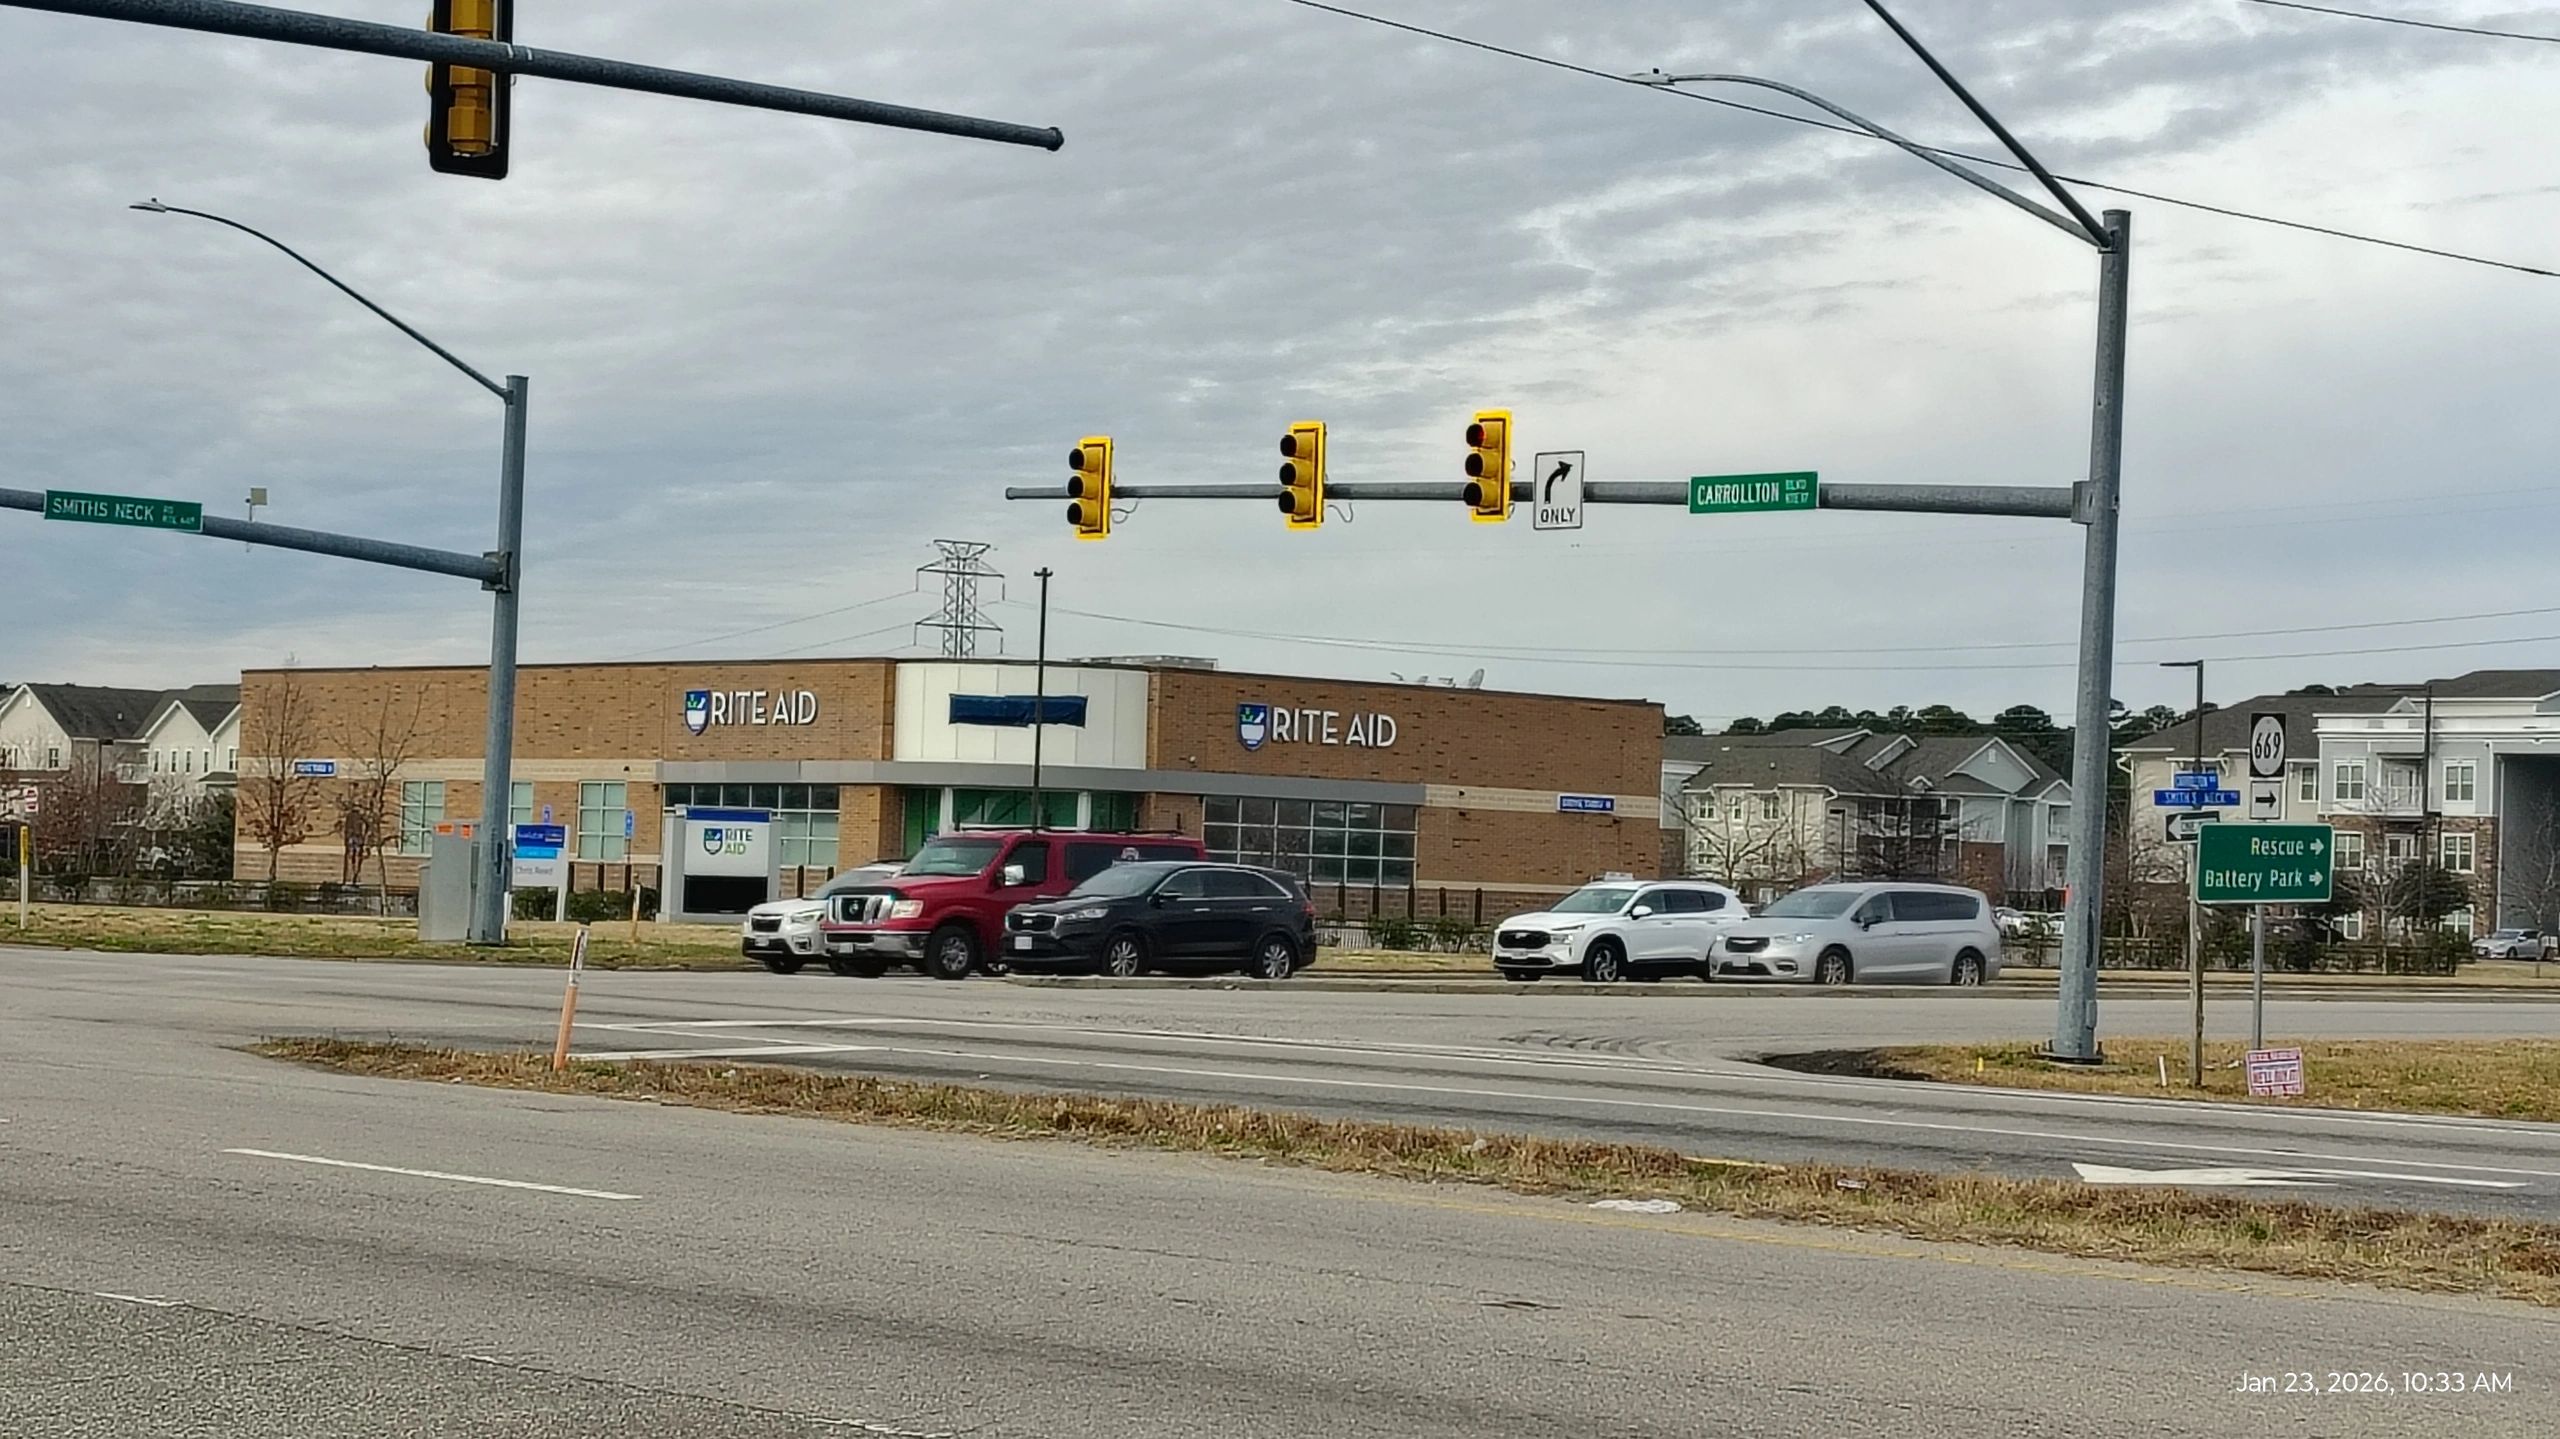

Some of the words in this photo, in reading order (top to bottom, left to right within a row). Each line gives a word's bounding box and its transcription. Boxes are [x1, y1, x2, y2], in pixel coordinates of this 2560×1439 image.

[1697, 482, 1779, 505] CARROLLTON
[52, 498, 108, 517] SMITHS
[115, 503, 154, 521] NECK
[1540, 508, 1575, 524] ONLY
[711, 690, 768, 725] RITE
[772, 689, 817, 725] AID
[1272, 706, 1340, 744] RITE
[1345, 713, 1397, 747] AID
[2254, 731, 2281, 760] 669
[725, 828, 753, 841] RITE
[724, 843, 746, 855] AID
[2251, 837, 2304, 856] Rescue
[2205, 869, 2262, 893] Battery
[2270, 868, 2303, 888] Park
